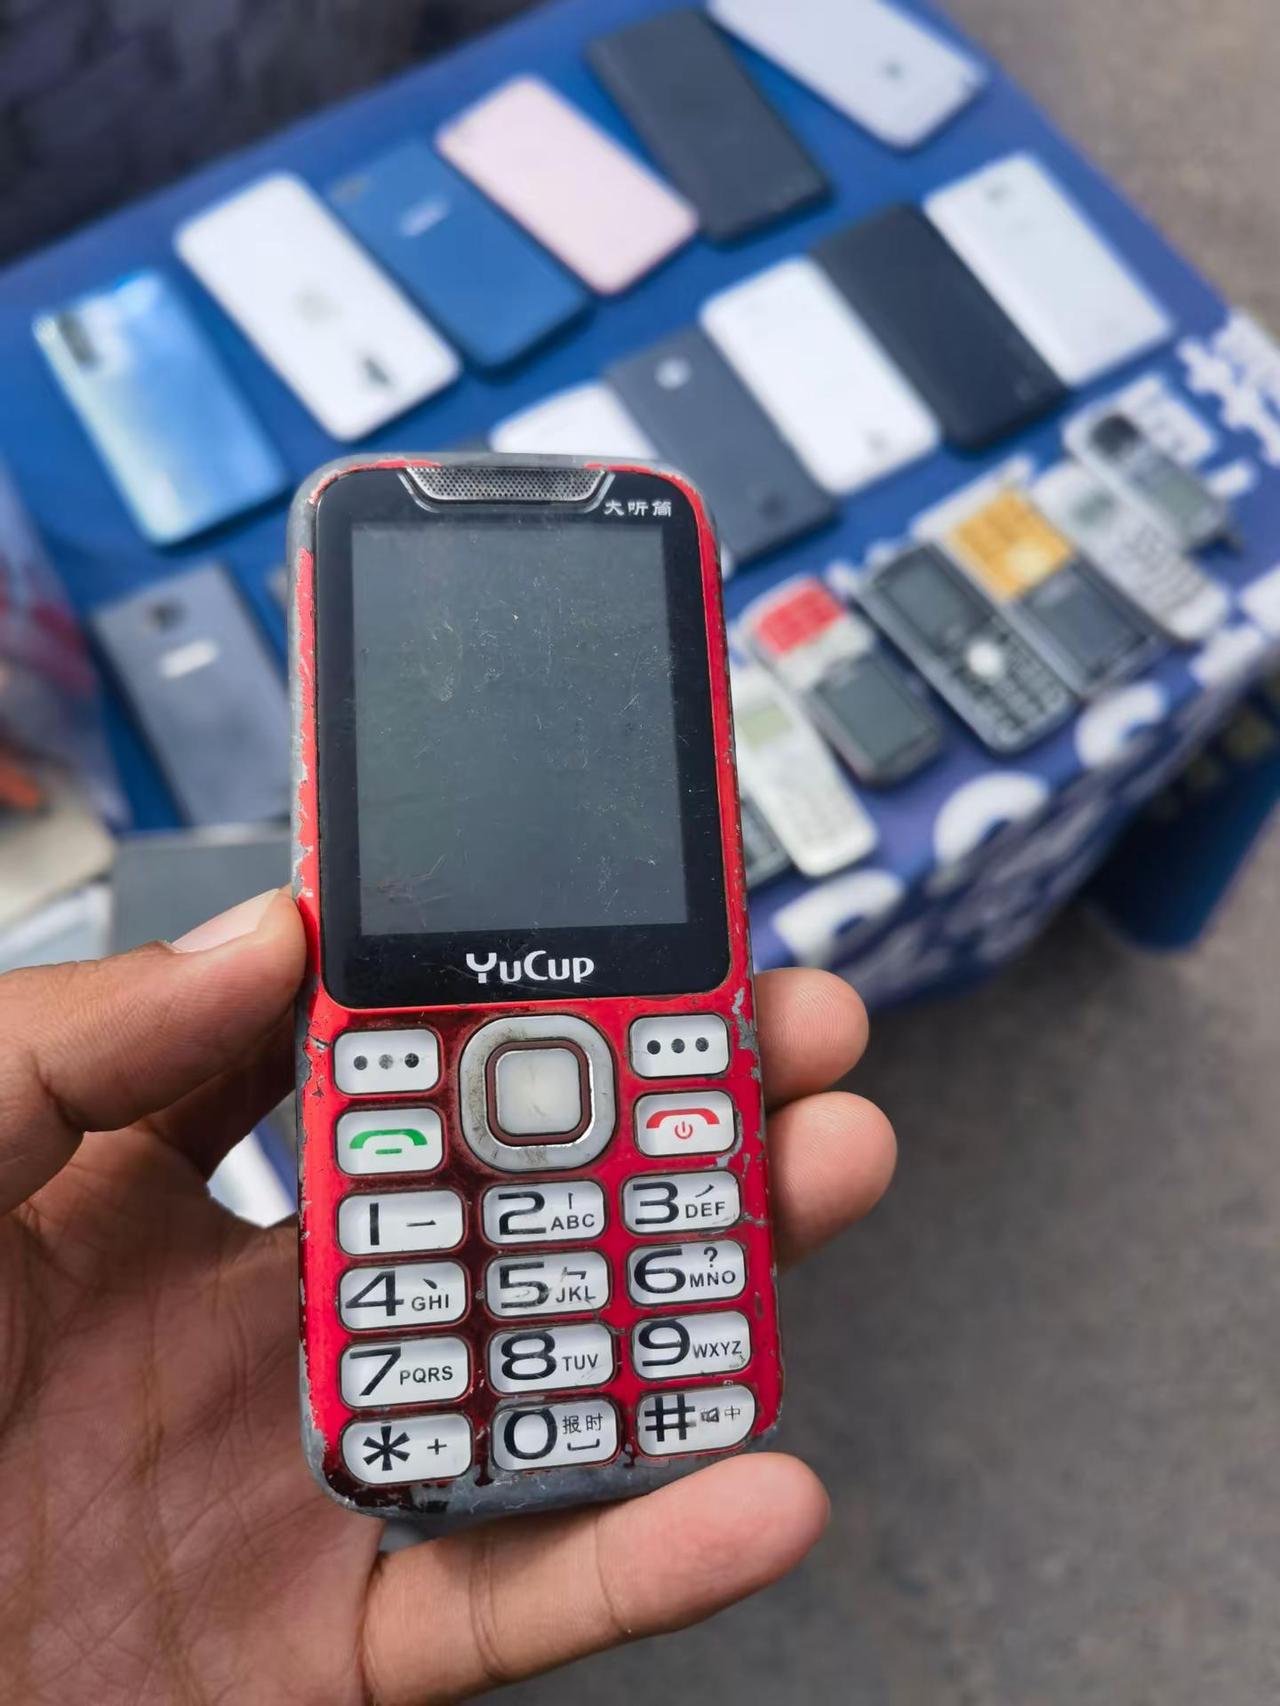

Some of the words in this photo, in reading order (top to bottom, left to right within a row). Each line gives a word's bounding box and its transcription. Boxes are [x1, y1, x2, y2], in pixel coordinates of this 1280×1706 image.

[603, 499, 673, 517] 大听筒
[465, 949, 595, 984] YuCup
[369, 1202, 380, 1246] 1
[498, 1190, 547, 1236] 2
[550, 1213, 596, 1231] ABC
[632, 1181, 680, 1225] 3
[685, 1201, 726, 1219] DEF
[345, 1270, 405, 1317] 4
[411, 1293, 449, 1312] GHI
[499, 1261, 550, 1309] 5
[555, 1285, 596, 1303] JKL
[633, 1247, 687, 1294] 6
[689, 1270, 736, 1289] MNO
[500, 1329, 557, 1381] 8
[562, 1353, 599, 1372] TUV
[638, 1319, 691, 1367] 9
[692, 1340, 742, 1359] WXYZ
[349, 1346, 402, 1396] 7
[400, 1365, 454, 1386] PQRS
[562, 1412, 603, 1435] 报时
[724, 1405, 741, 1420] 中
